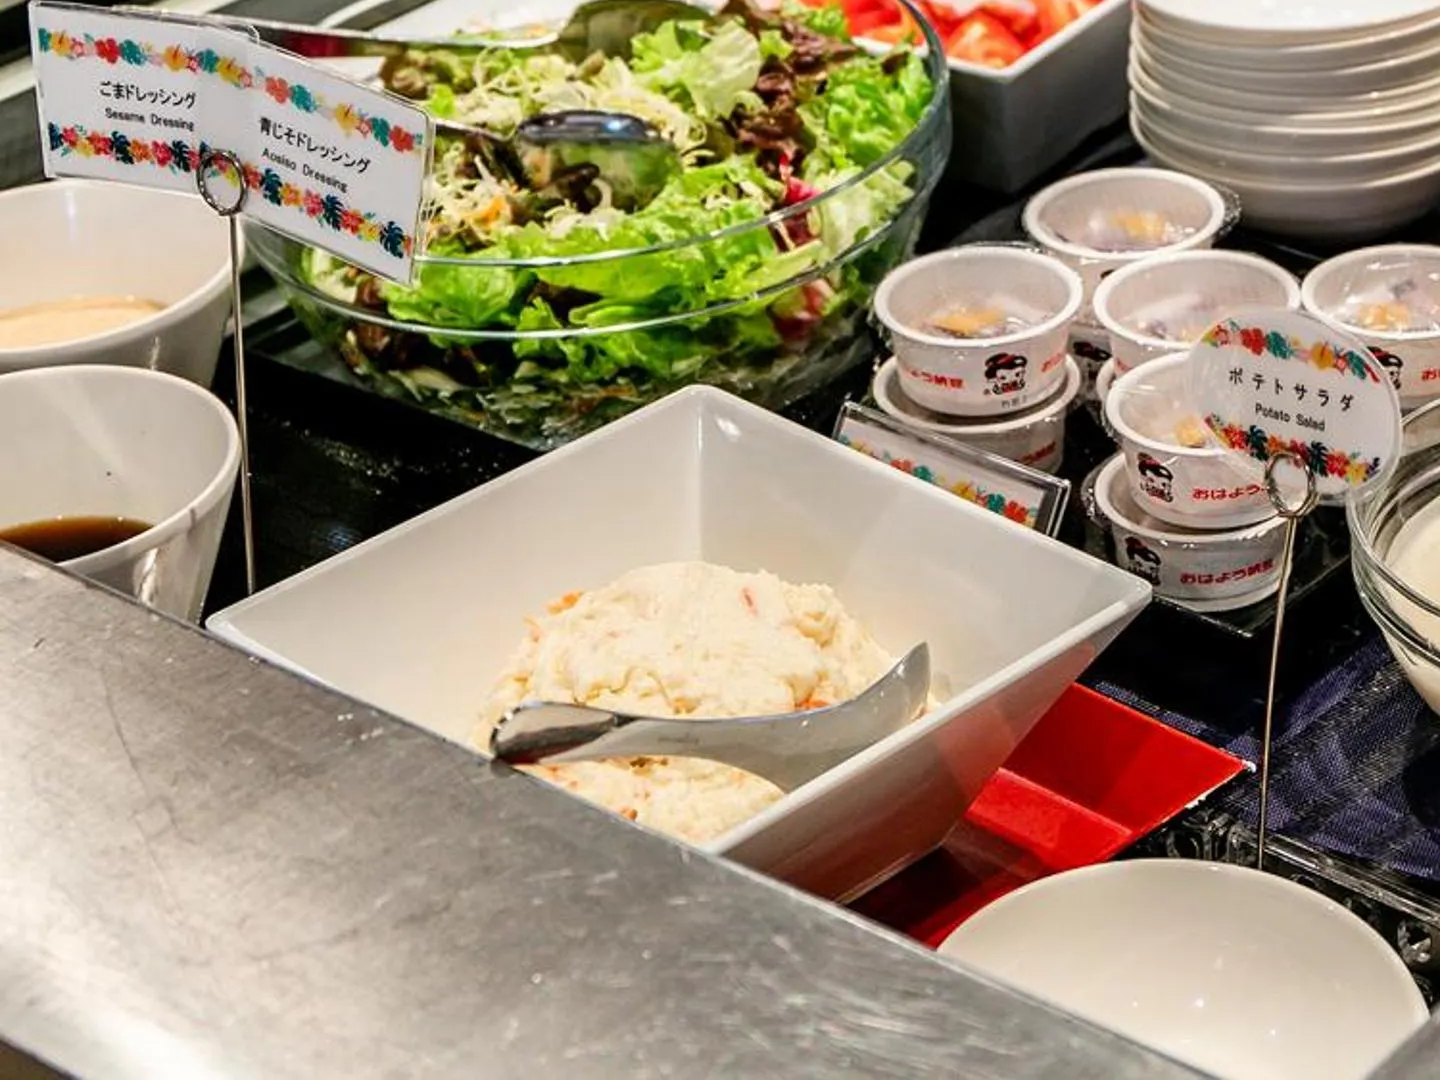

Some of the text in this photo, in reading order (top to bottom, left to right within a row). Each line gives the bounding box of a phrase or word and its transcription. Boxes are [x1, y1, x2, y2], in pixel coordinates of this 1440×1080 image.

[100, 80, 196, 109] ごまドレッシング
[104, 107, 194, 132] Sesame Dressing
[260, 117, 371, 173] 青じそドレッシング
[302, 164, 348, 193] Dressing
[1229, 368, 1354, 411] ポテトサラダ
[1255, 403, 1325, 431] Potato Salad
